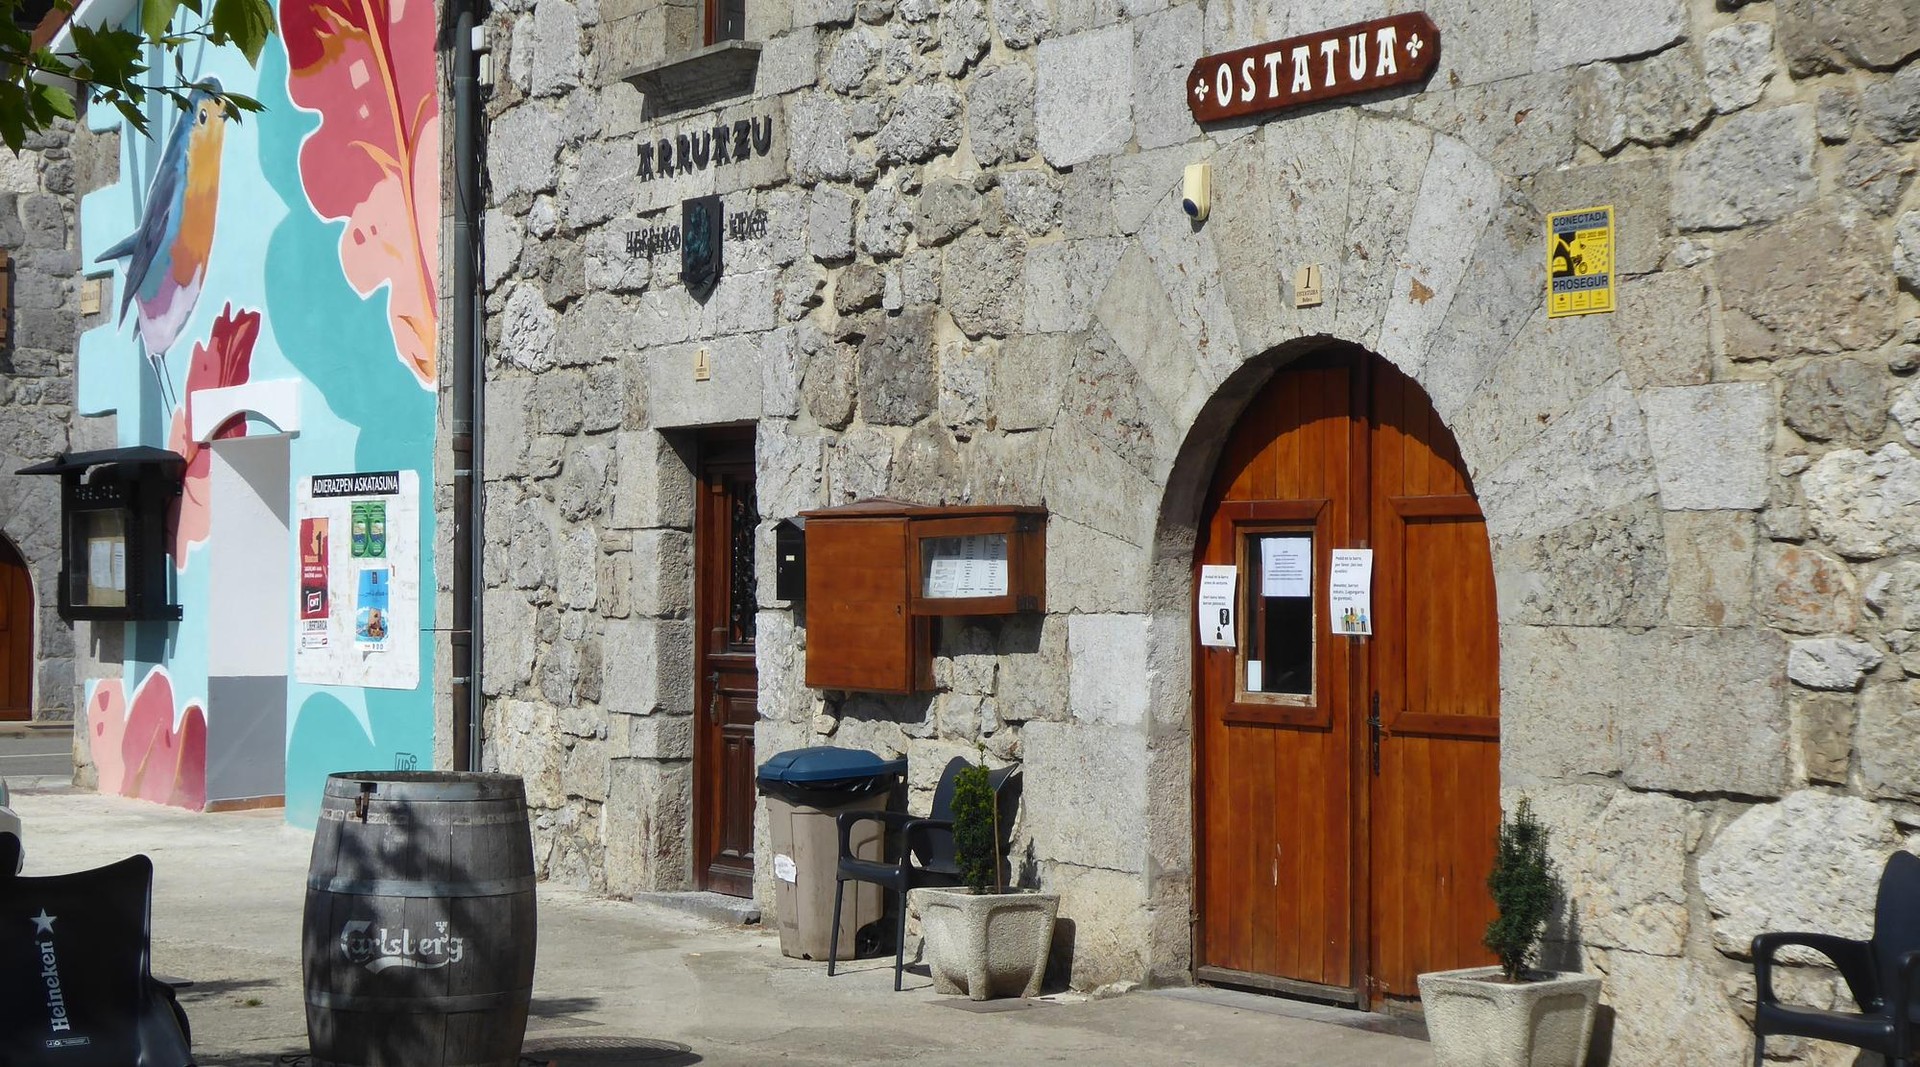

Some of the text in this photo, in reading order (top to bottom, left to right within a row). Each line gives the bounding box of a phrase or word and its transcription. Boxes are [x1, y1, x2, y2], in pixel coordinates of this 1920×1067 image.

[1216, 26, 1398, 107] OSTATUA
[636, 115, 773, 182] ARRUAZU
[1553, 211, 1608, 227] CONECTADA
[625, 223, 681, 256] HERRIKO
[1303, 266, 1311, 289] 1
[1553, 276, 1609, 292] PROSEGUR
[313, 475, 398, 494] ADIERAZPEN ASKATASUNA
[40, 940, 71, 1032] Heineken
